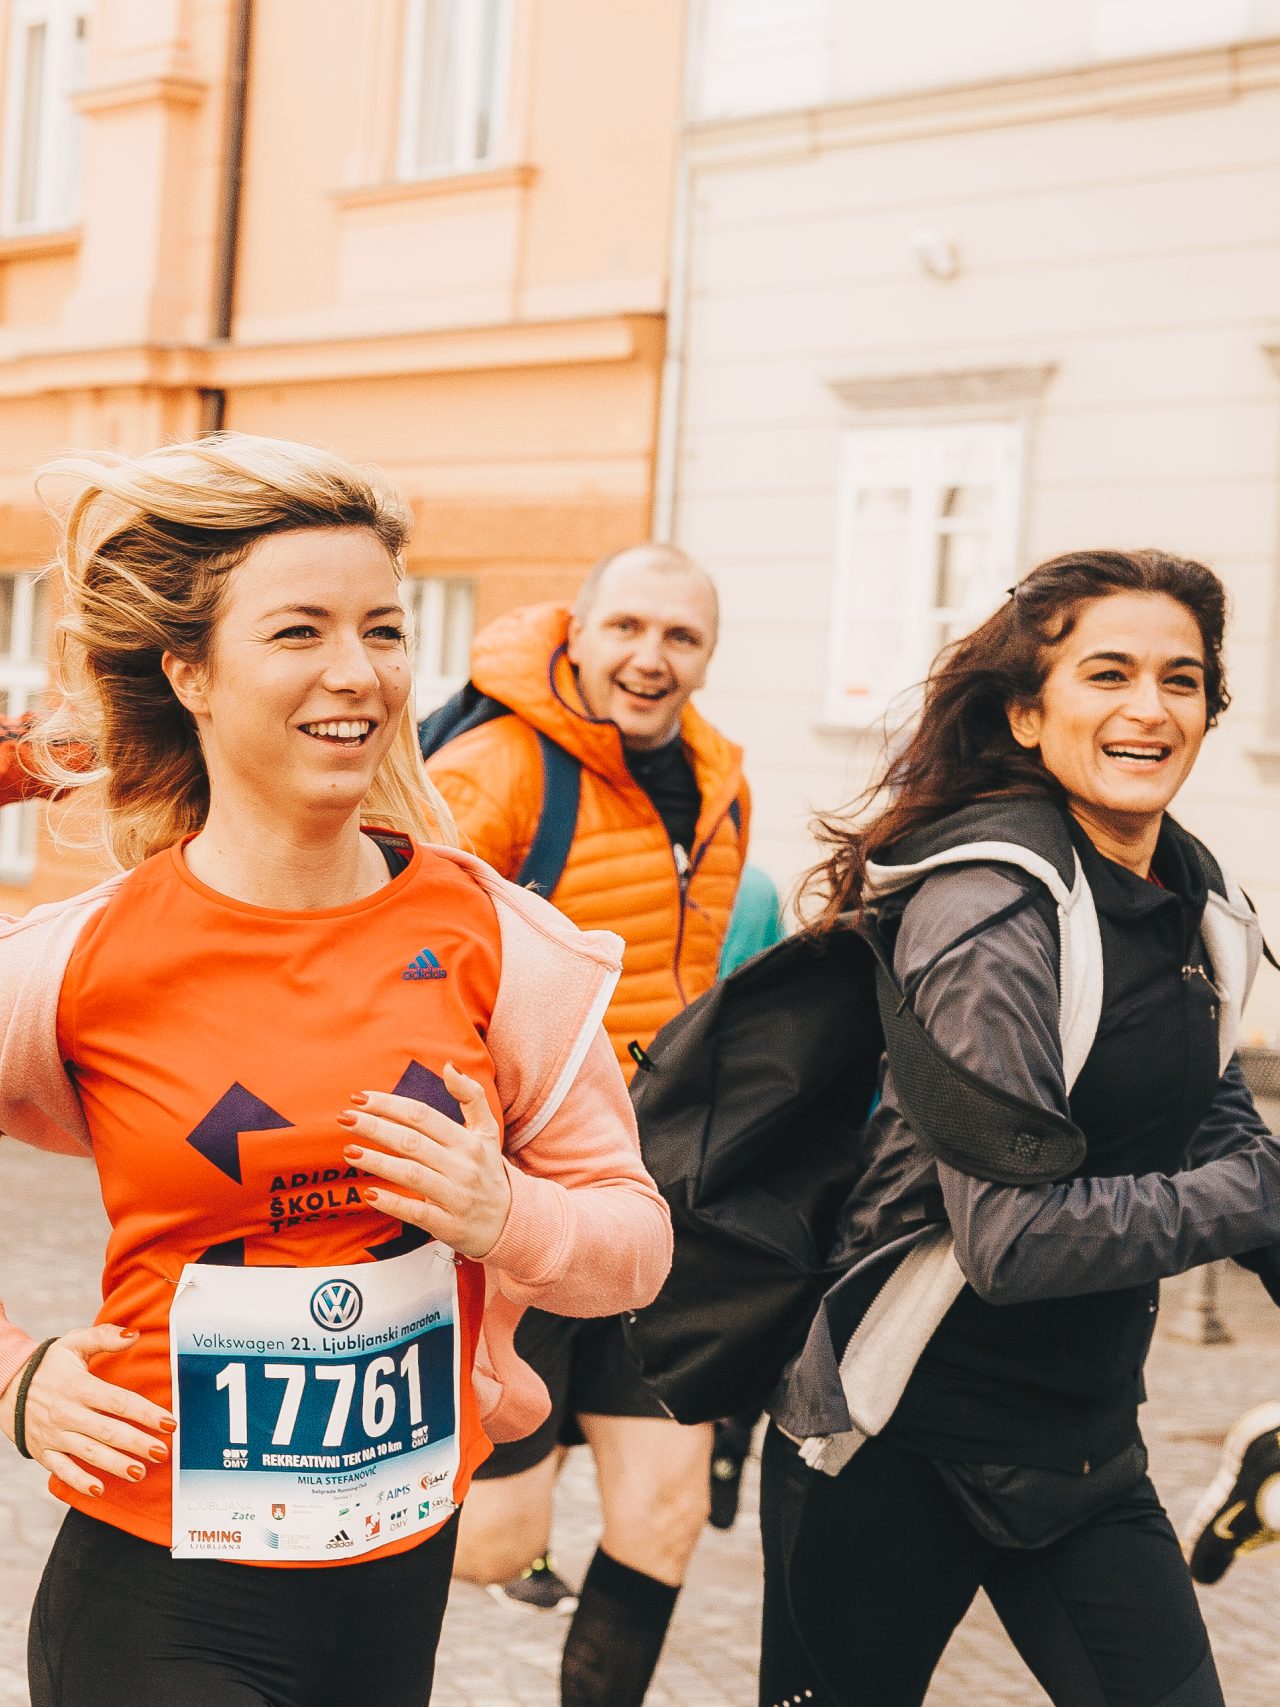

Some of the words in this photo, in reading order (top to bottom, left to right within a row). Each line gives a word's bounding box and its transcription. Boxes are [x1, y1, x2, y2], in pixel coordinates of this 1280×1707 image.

[402, 968, 447, 980] adidas
[270, 1187, 362, 1217] ŠKOLA
[192, 1333, 285, 1353] Volkswagen
[290, 1337, 317, 1351] 21.
[323, 1326, 399, 1355] Ljubljanski
[401, 1310, 441, 1337] maraton
[216, 1343, 423, 1447] 17761
[223, 1460, 248, 1468] OMV
[262, 1454, 341, 1469] REKREATIVNI
[342, 1451, 362, 1467] TEK
[362, 1447, 376, 1462] NA
[377, 1443, 387, 1456] 10
[388, 1441, 402, 1453] km
[297, 1475, 323, 1486] MILA
[325, 1465, 377, 1485] STEFANOVIĆ
[386, 1483, 411, 1501] AIMS
[188, 1530, 242, 1543] TIMING
[326, 1540, 354, 1550] adidas
